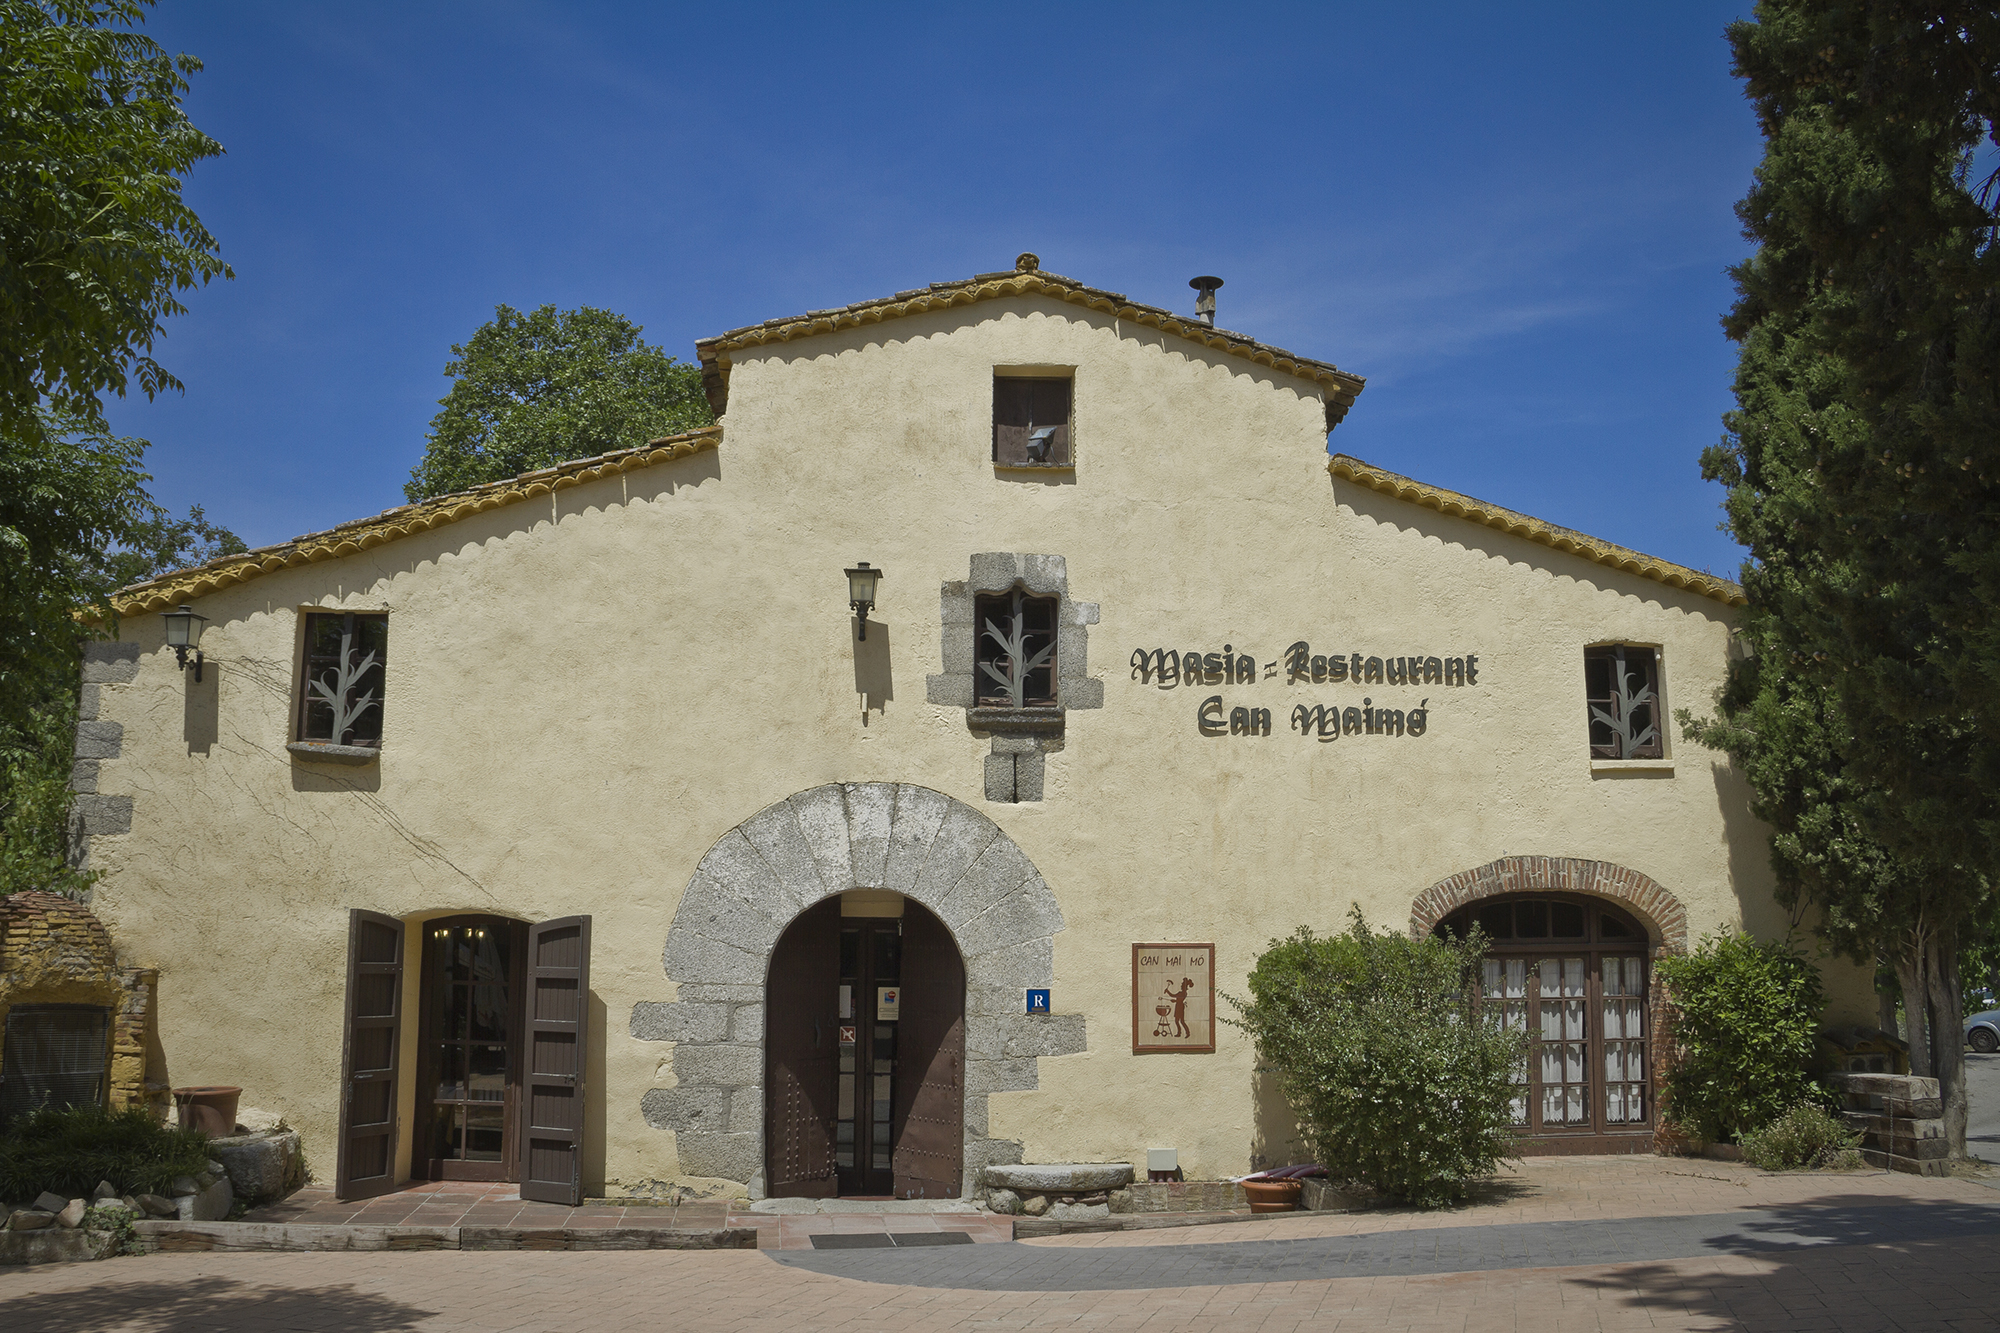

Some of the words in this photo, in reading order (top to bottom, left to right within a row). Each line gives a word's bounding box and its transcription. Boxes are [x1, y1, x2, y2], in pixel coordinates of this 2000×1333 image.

[1285, 641, 1479, 684] Restaurant
[1198, 695, 1272, 735] Can
[1291, 697, 1430, 740] Maimó
[1140, 955, 1160, 967] CAN
[1034, 994, 1044, 1007] R
